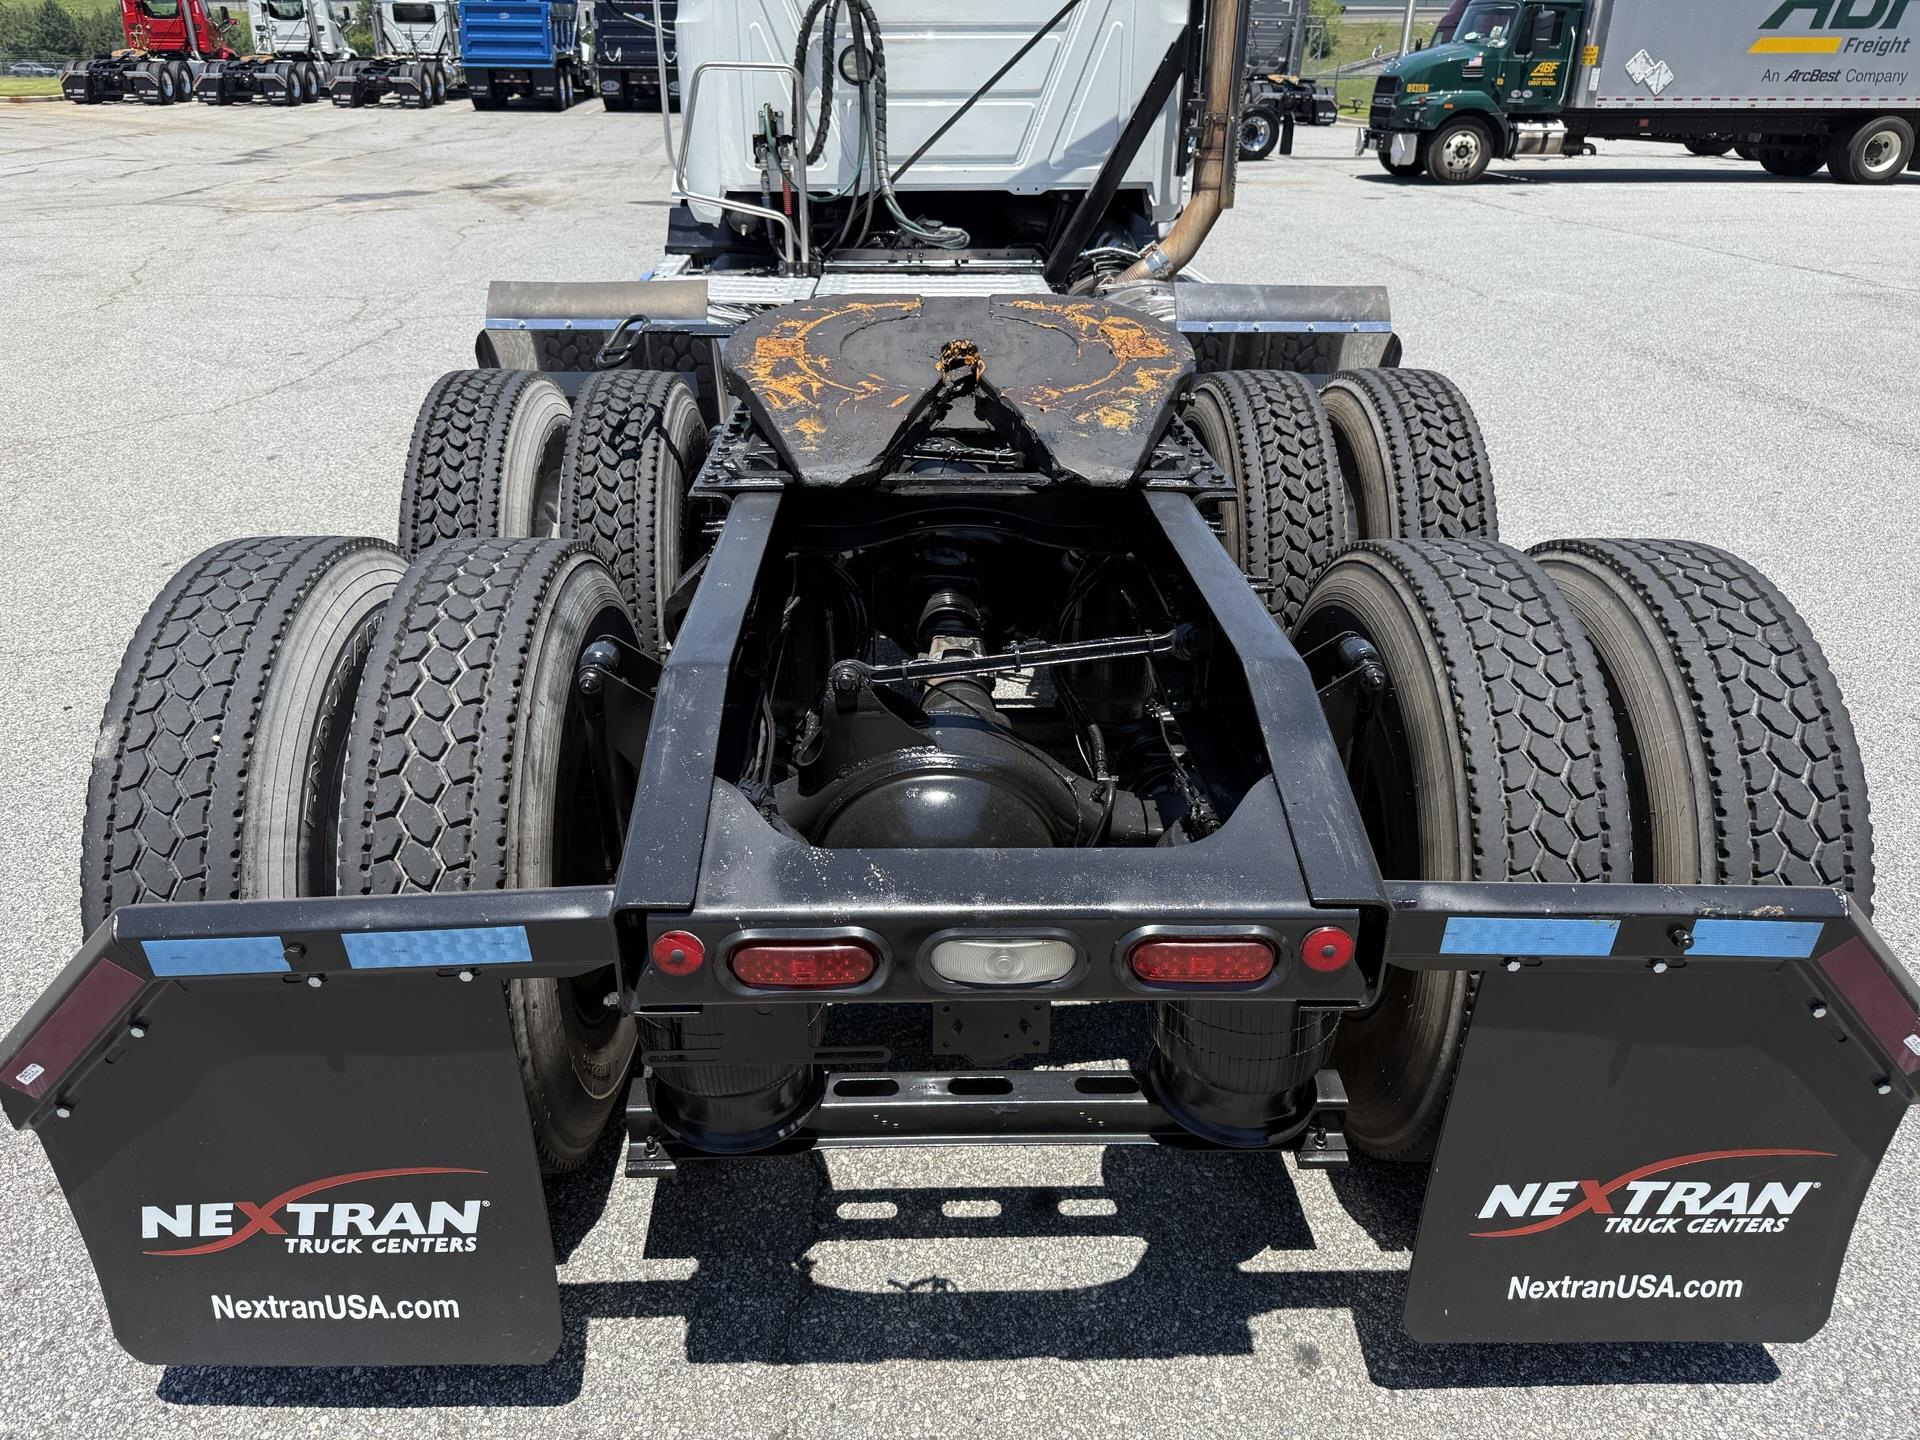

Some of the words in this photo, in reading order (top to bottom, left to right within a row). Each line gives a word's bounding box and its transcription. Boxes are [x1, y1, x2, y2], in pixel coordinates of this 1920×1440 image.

[1843, 36, 1911, 57] Freight
[1533, 62, 1561, 73] ABF
[1761, 69, 1780, 83] An
[1784, 69, 1842, 83] ArcBest
[1845, 69, 1909, 86] Company
[1604, 1217, 1679, 1234] TRUCK
[1686, 1217, 1790, 1234] CENTERS
[284, 1238, 363, 1254] TRUCK
[371, 1236, 477, 1253] CENTERS
[1507, 1274, 1744, 1300] NextranUSA.com
[211, 1294, 460, 1320] NextranUSA.com
